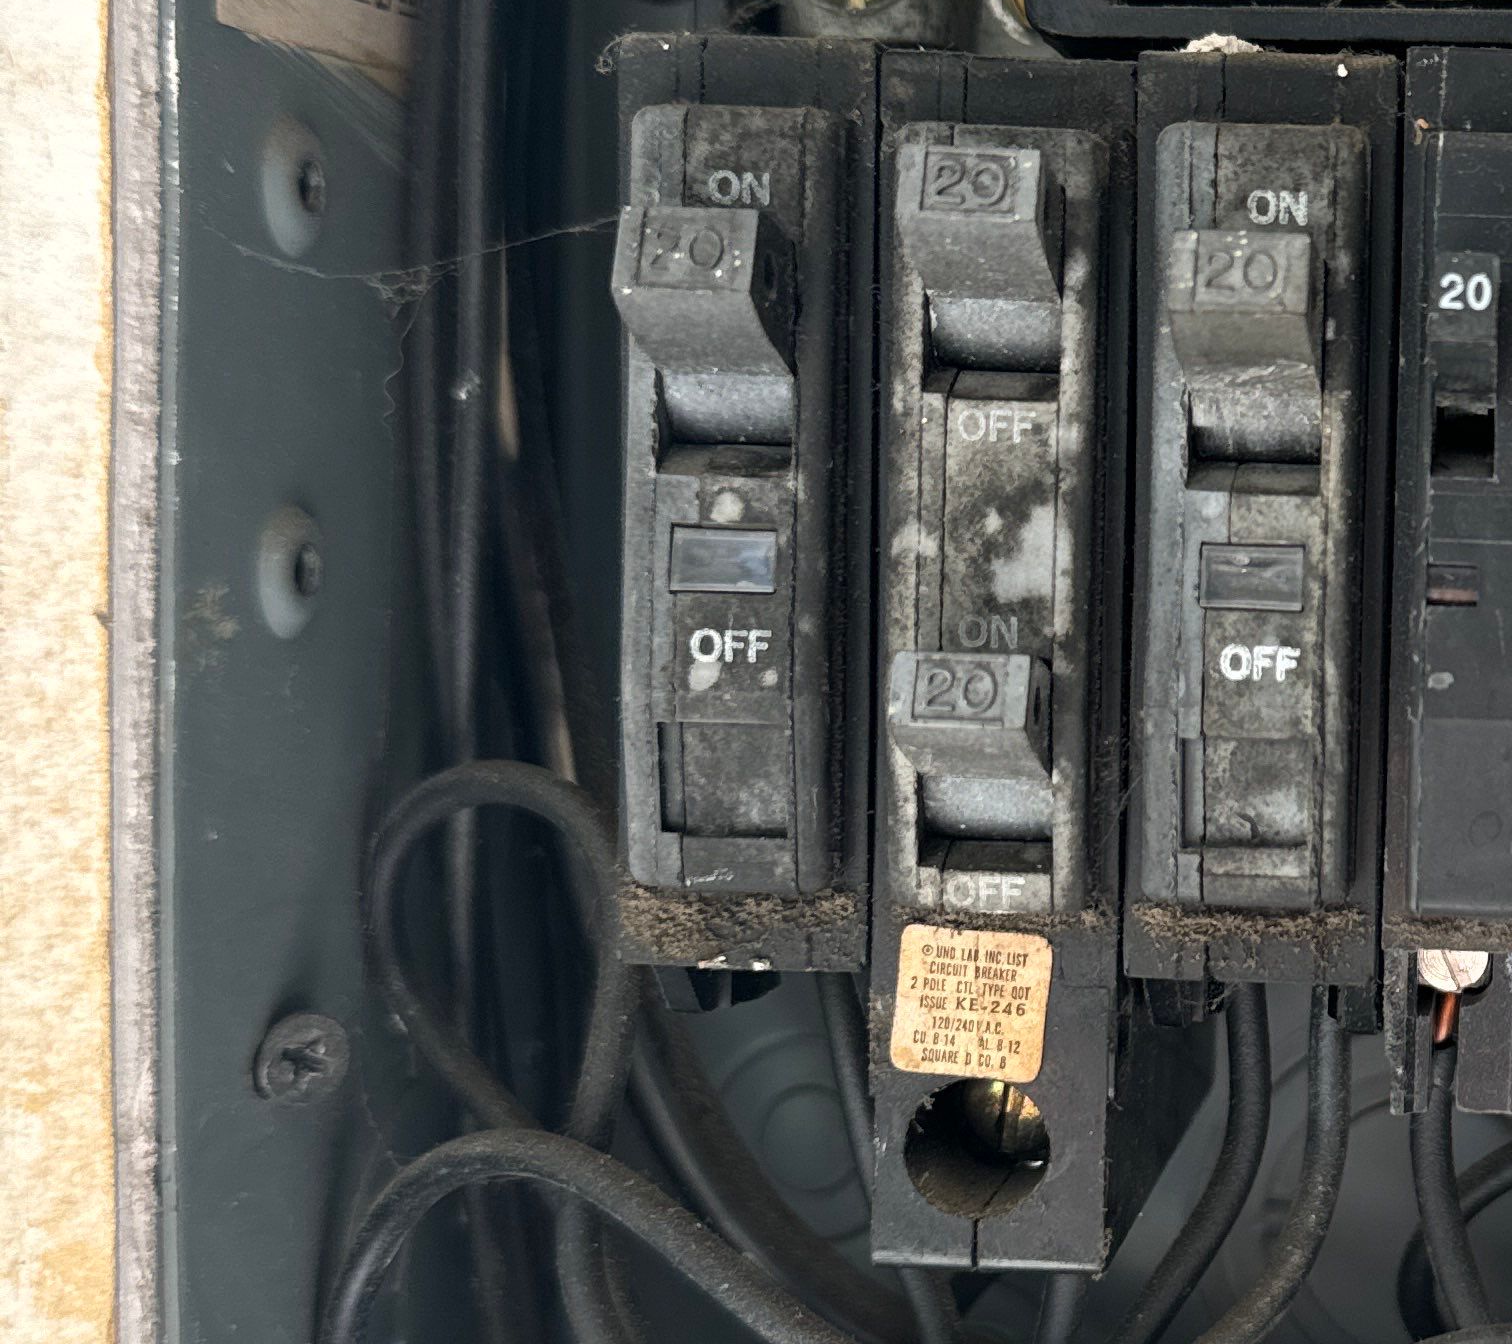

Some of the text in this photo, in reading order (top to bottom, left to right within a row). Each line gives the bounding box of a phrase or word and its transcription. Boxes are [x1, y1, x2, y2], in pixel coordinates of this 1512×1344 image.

[707, 169, 771, 207] ON
[934, 157, 1009, 208] 20
[1245, 190, 1309, 226] ON
[647, 224, 725, 273] 20
[1205, 250, 1280, 294] 20
[1438, 273, 1493, 311] 20
[957, 409, 1037, 444] OFF
[690, 628, 772, 664] OFF
[958, 616, 1019, 650] ON
[1219, 643, 1302, 683] OFF
[927, 668, 998, 713] 20
[945, 876, 1025, 910] OFF
[929, 961, 1018, 982] CIRCUIT BREAKER
[1006, 952, 1029, 968] LIST
[910, 975, 1031, 1001] 2 POLE CTL TYPE QOT
[920, 994, 1026, 1016] ISSUE KE-246
[921, 1047, 959, 1064] SQUARE
[965, 1051, 972, 1066] D
[978, 1053, 994, 1069] CO.
